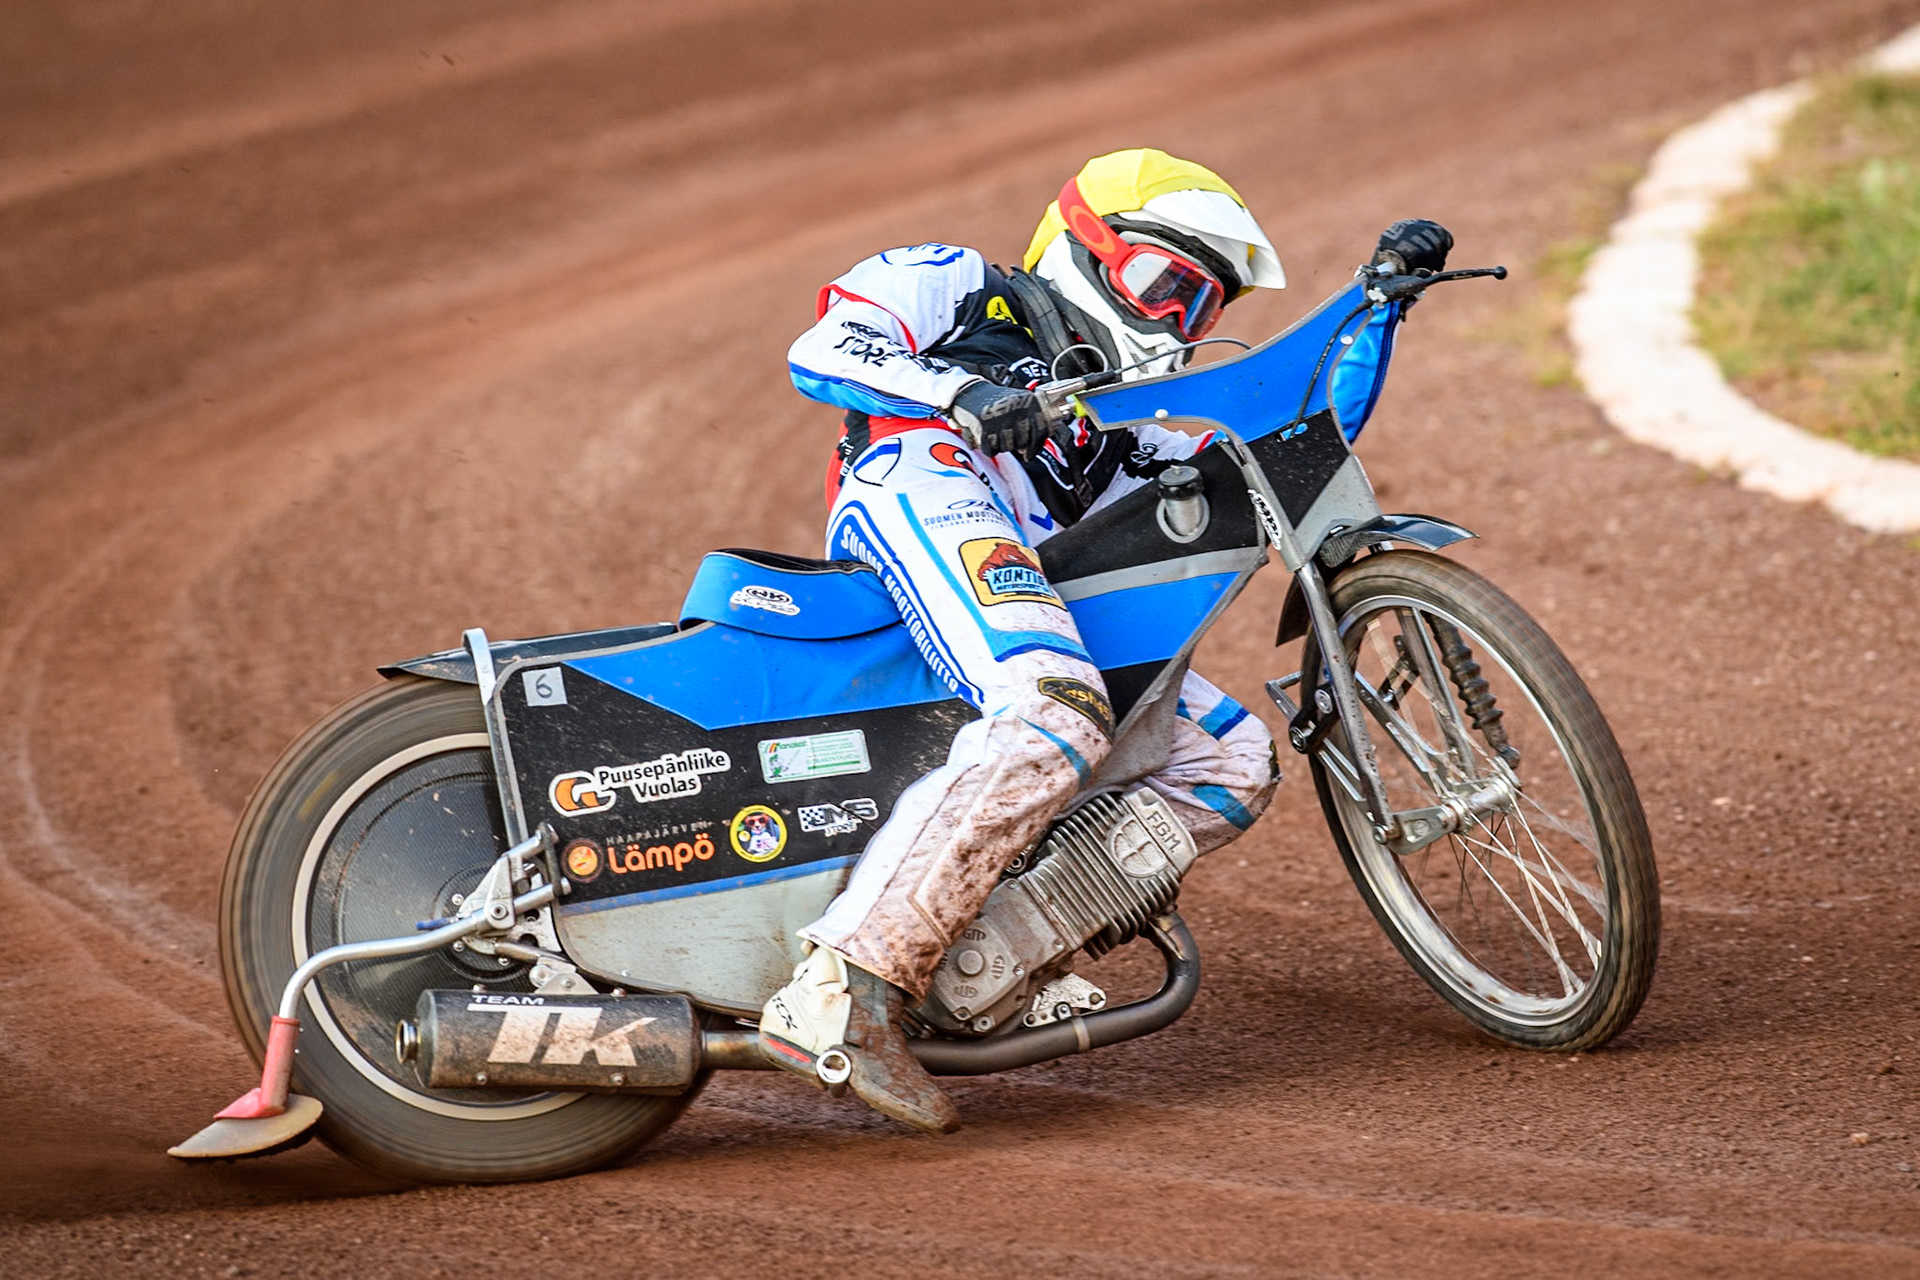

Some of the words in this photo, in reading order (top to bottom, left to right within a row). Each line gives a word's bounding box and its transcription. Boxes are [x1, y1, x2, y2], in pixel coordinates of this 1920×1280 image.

[833, 335, 896, 367] STORE
[923, 513, 962, 526] SUOMEN
[536, 672, 553, 699] 6
[599, 752, 726, 785] Puusepänliike
[635, 776, 697, 798] Vuolas
[607, 832, 715, 874] Lämpö
[471, 994, 545, 1006] TEAM
